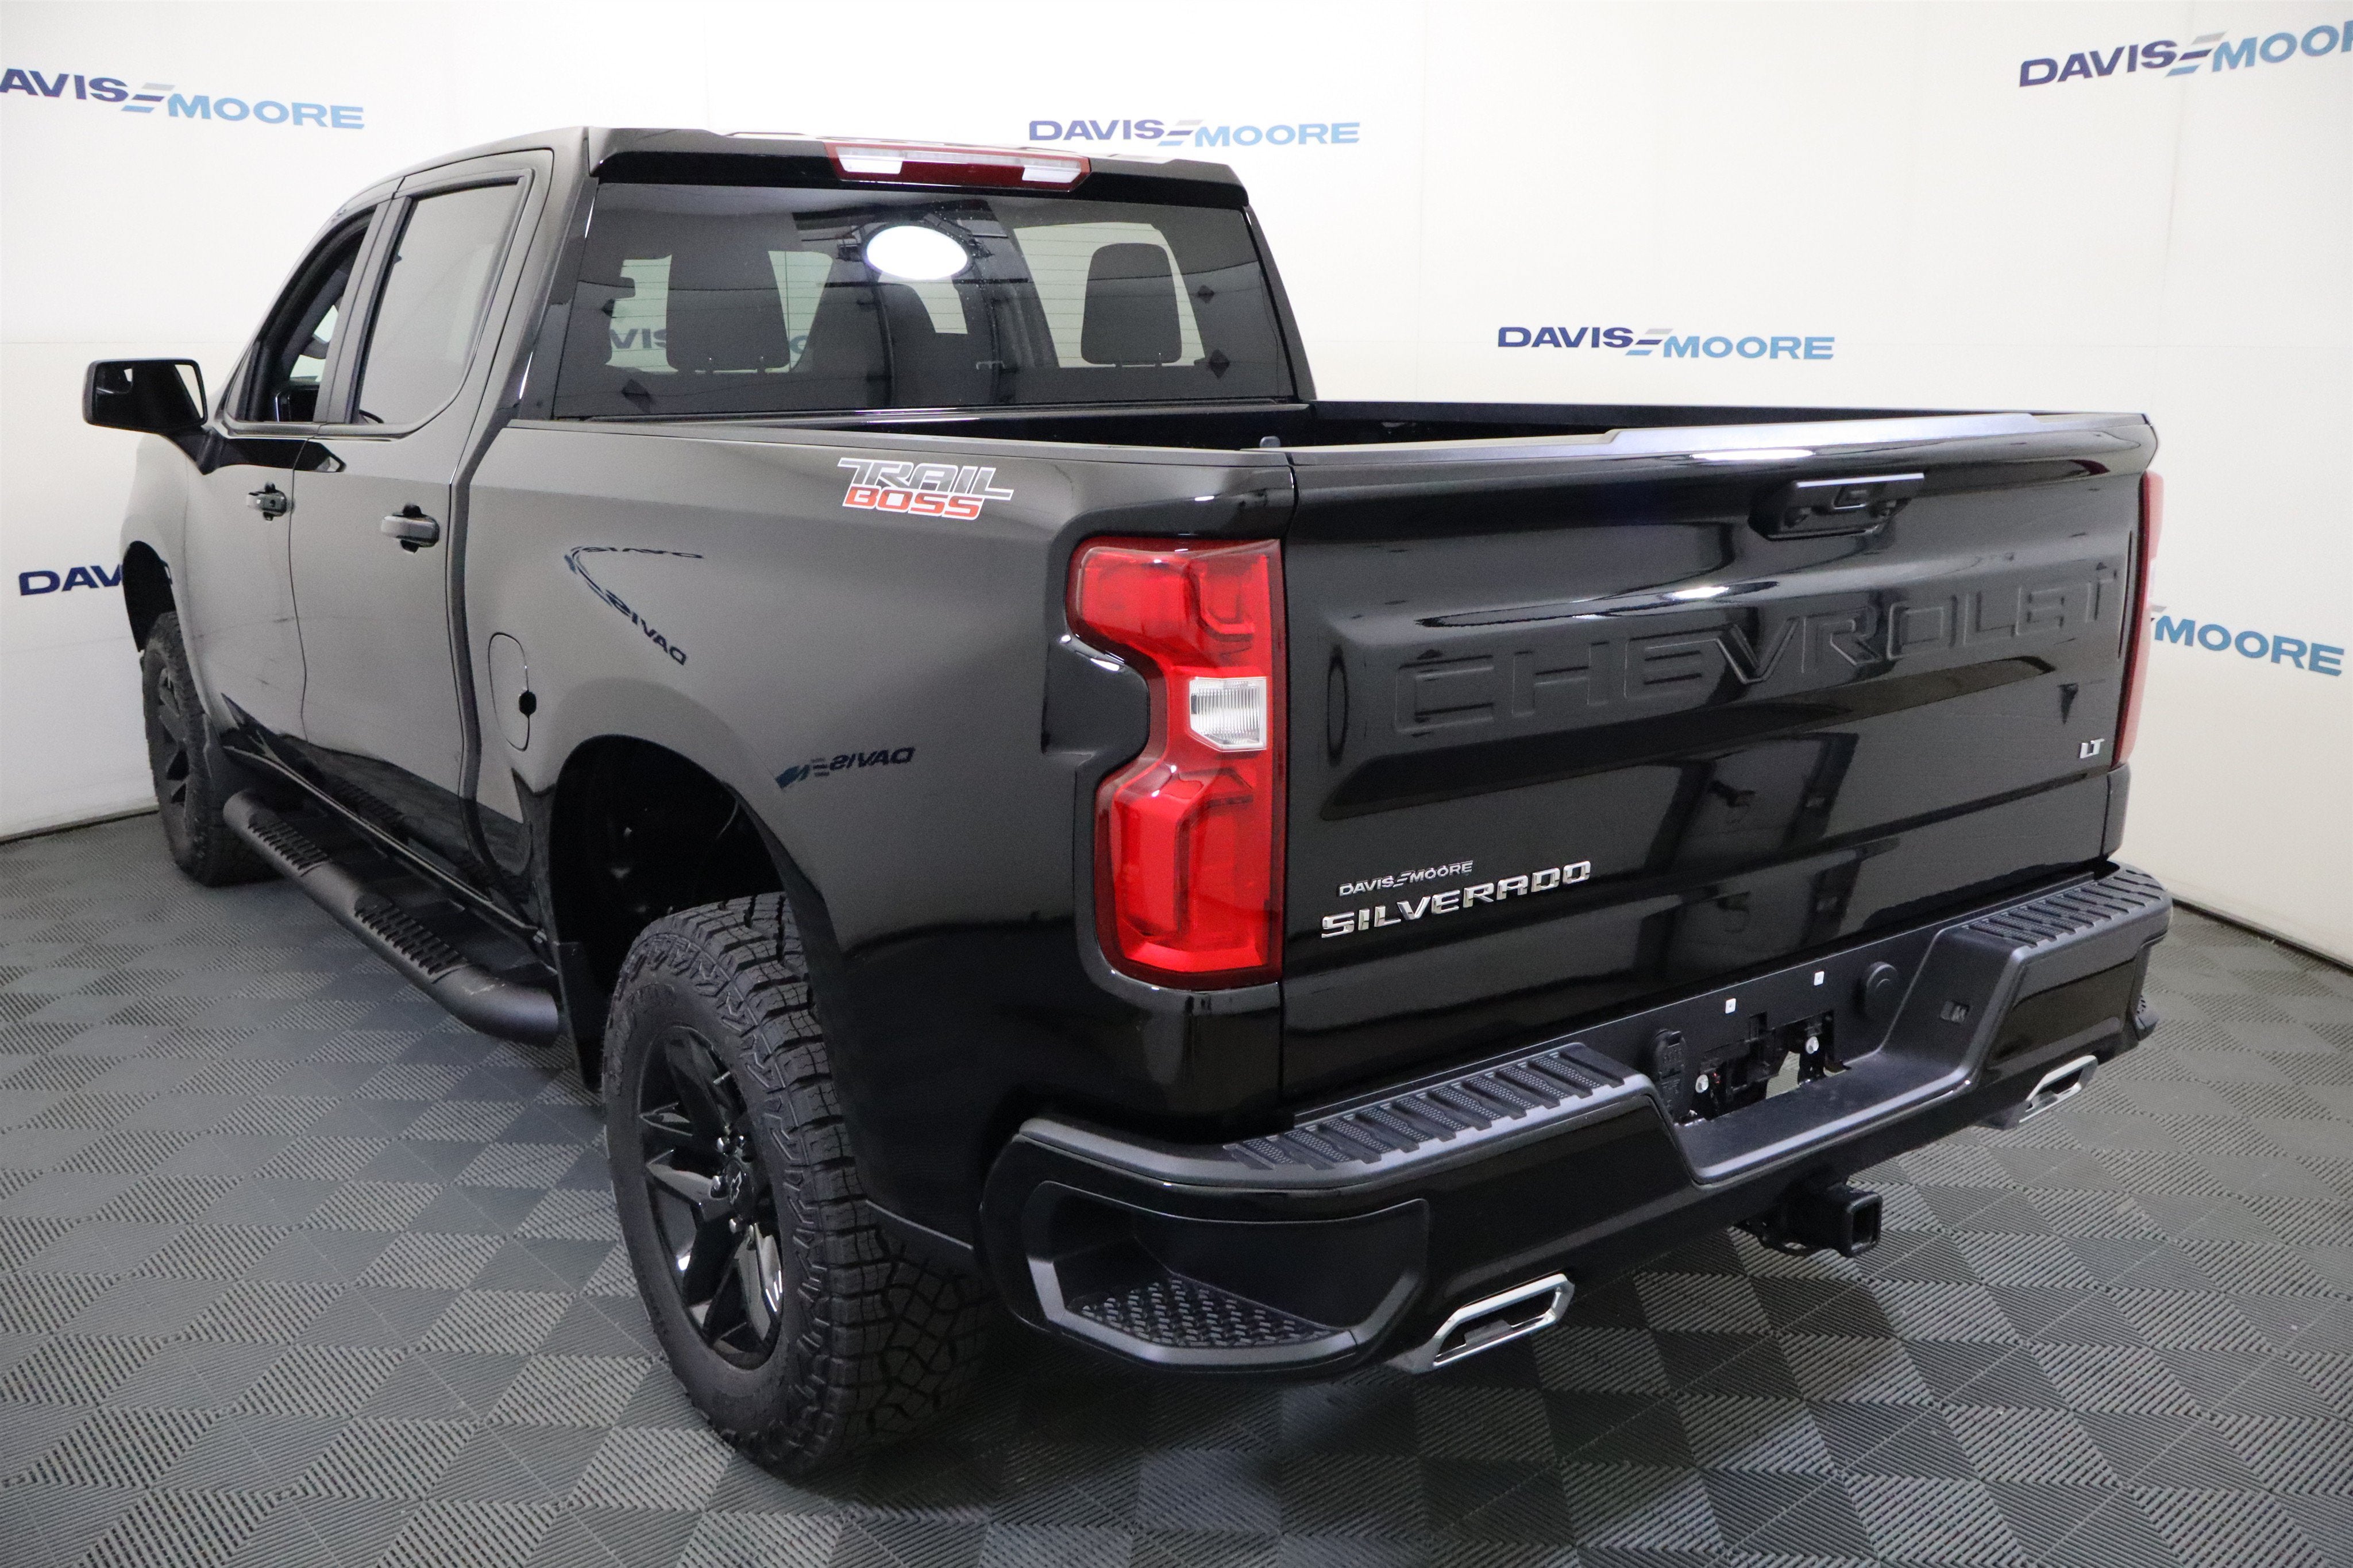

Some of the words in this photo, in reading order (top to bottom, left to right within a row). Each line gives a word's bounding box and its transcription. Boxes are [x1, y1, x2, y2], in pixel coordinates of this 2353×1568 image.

[2019, 40, 2178, 87] DAVIS
[2212, 20, 2353, 72] MOO
[0, 68, 130, 102] AVIS
[167, 93, 365, 130] MOORE
[1029, 119, 1165, 141] DAVIS
[1194, 122, 1360, 148] MOORE
[1498, 327, 1634, 348] DAVIS
[1662, 335, 1835, 360] MOORE
[837, 457, 1015, 501] TRAIL
[842, 485, 985, 520] BOSS
[18, 564, 122, 596] DAV
[1394, 569, 2117, 734] CHEVROLET
[2154, 615, 2344, 677] MOORE
[2079, 738, 2105, 759] LT
[1337, 875, 1395, 897] DAVIS
[1409, 860, 1473, 883] MOORE
[1321, 860, 1591, 939] SILVERADO
